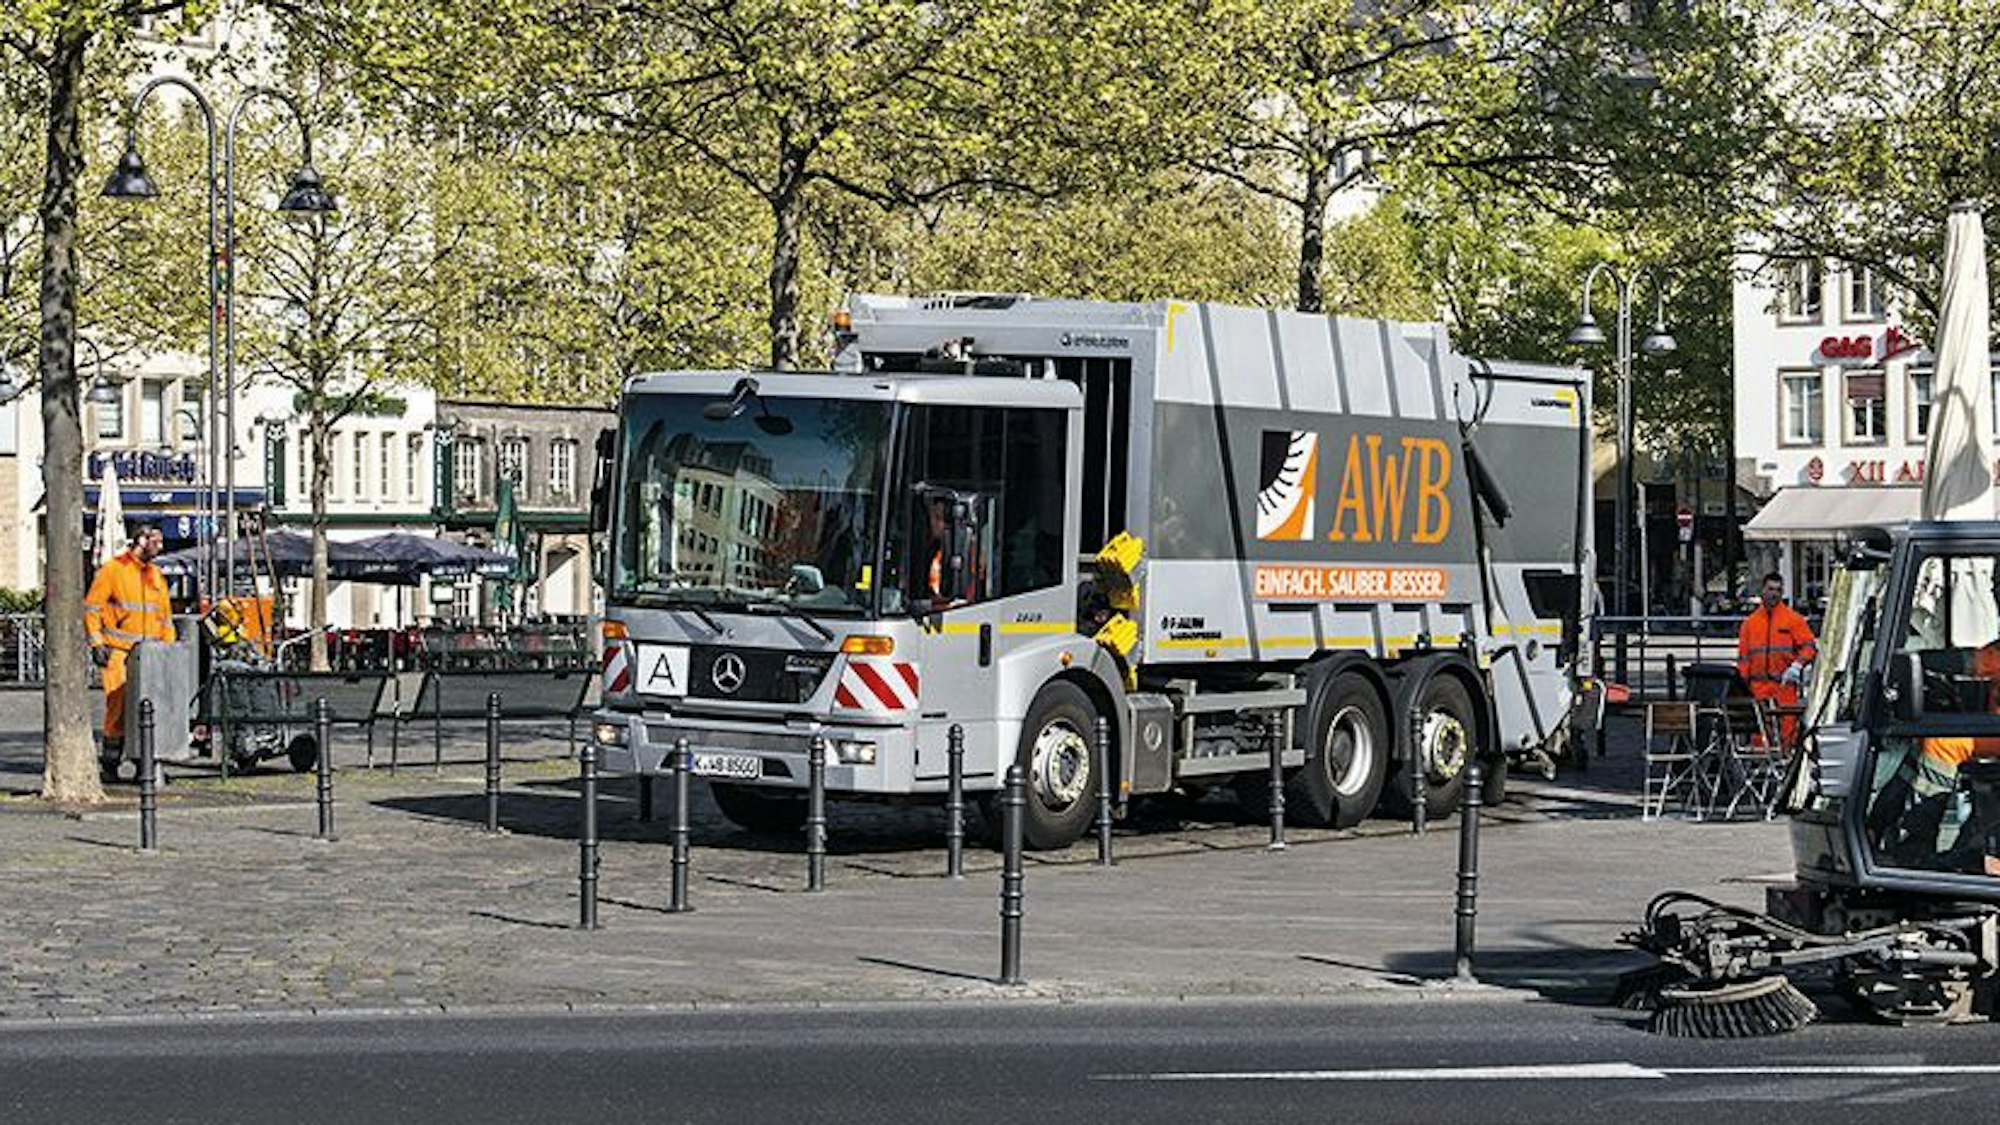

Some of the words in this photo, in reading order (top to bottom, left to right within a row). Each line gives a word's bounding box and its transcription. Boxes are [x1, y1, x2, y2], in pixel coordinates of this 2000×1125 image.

[1851, 459, 1885, 482] XII
[1327, 432, 1451, 544] AWB
[1256, 568, 1326, 595] EINFACH.
[1328, 569, 1389, 596] SAUBER.
[1390, 570, 1445, 597] BESSER.
[648, 653, 676, 688] A
